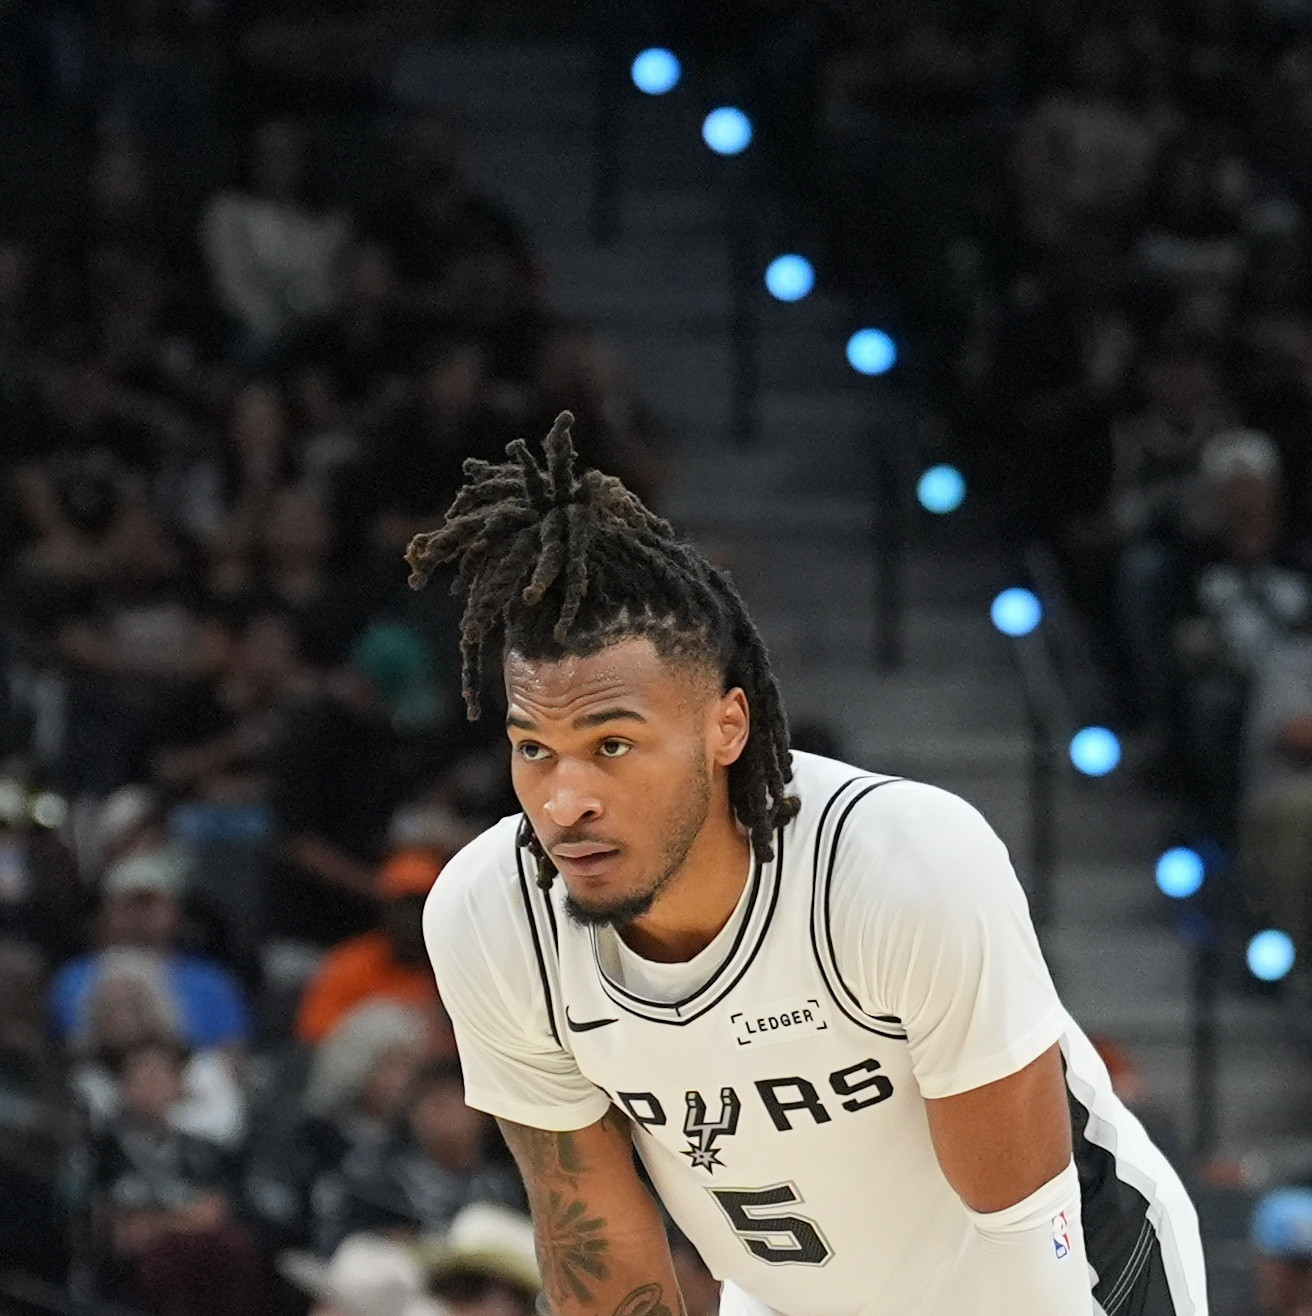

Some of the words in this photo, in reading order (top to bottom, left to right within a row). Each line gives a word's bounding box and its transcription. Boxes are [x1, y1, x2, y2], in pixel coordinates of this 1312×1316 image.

[745, 1009, 814, 1034] LEDGER
[600, 1058, 894, 1175] PURS
[704, 1180, 835, 1267] 5
